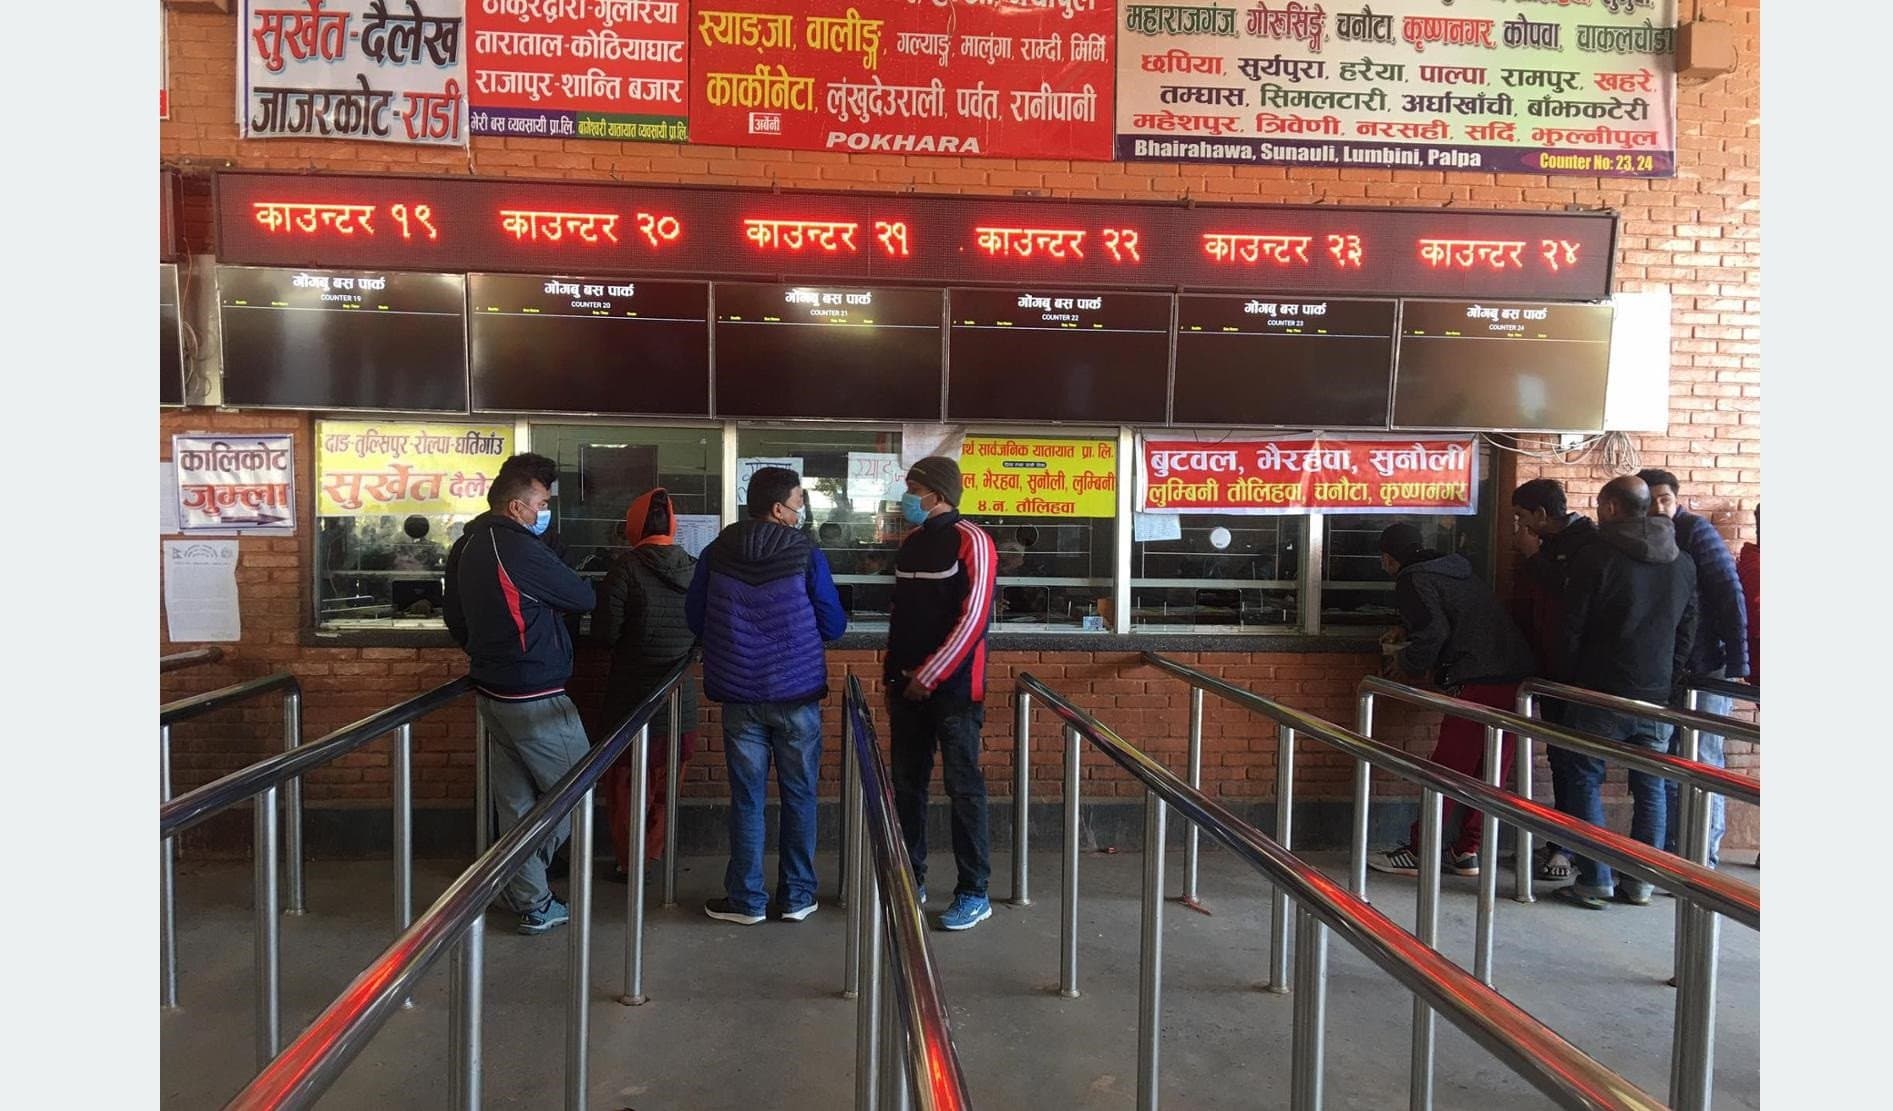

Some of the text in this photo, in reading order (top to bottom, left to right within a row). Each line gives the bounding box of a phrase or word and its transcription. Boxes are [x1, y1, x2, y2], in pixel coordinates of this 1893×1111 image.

[629, 77, 685, 103] बजार
[1010, 82, 1097, 123] रानीपानी
[491, 117, 505, 132] बस
[827, 132, 980, 153] POKHARA
[1134, 140, 1482, 169] Bhairahawa, Sunauli, Lumbini, Palpa
[1540, 152, 1592, 171] Counter
[1594, 154, 1615, 171] No:
[1639, 155, 1654, 172] 24
[253, 202, 438, 239] काउन्टर १९
[499, 210, 681, 246] काउन्टर २०
[743, 219, 910, 256] काउन्टर २१
[975, 227, 1141, 262] काउन्टर २२
[1203, 234, 1364, 268] काउन्टर २३
[1419, 240, 1582, 272] काउन्टर २४
[321, 294, 352, 302] COUNTER
[333, 277, 354, 290] बस
[359, 276, 386, 291] पार्क
[584, 285, 603, 297] बस
[608, 284, 635, 297] पार्क
[822, 292, 842, 304] बस
[846, 291, 873, 305] पार्क
[1055, 298, 1074, 310] बस
[1077, 297, 1102, 310] पार्क
[1280, 304, 1299, 315] बस
[1302, 303, 1327, 315] पार्क
[1502, 308, 1520, 320] बस
[1523, 307, 1547, 320] पार्क
[180, 442, 289, 472] कालिकोट
[1033, 444, 1075, 457] यातायात
[1151, 442, 1465, 477] बुटवल, भैरहवा, सुनौली
[181, 484, 290, 514] जुम्ला
[323, 464, 495, 509] सुर्खेत दैले
[1149, 477, 1218, 507] लुम्बिनी
[1380, 482, 1468, 506] कृष्णनगर
